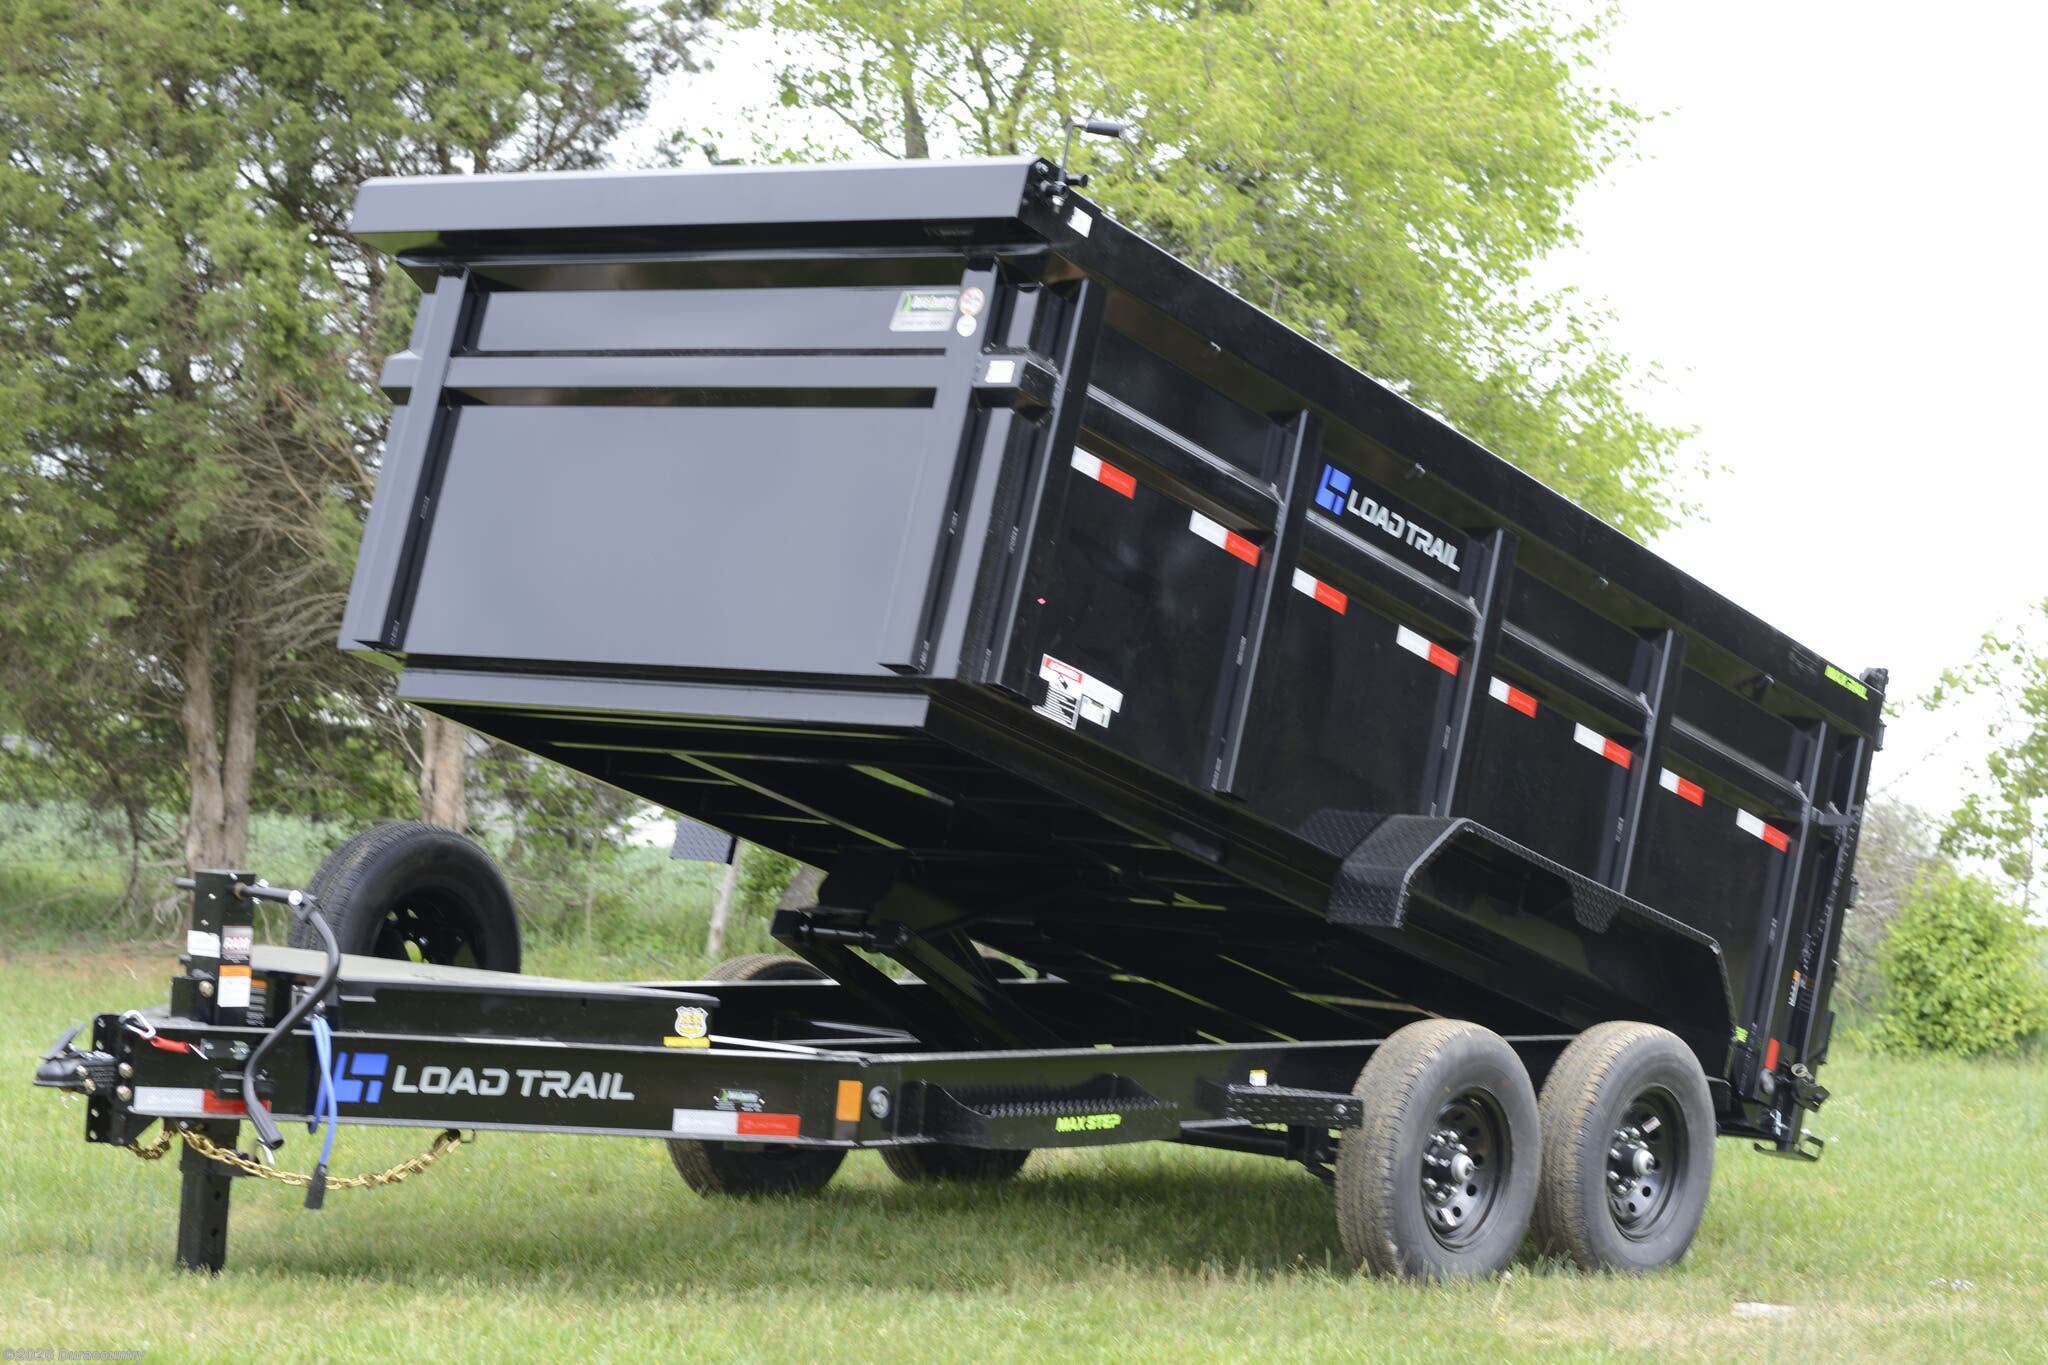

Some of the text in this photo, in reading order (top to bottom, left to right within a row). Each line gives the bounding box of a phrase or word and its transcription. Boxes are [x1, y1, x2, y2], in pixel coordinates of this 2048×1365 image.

[1346, 488, 1461, 573] LOAD TRAIL
[392, 1064, 635, 1101] LOAD TRAIL
